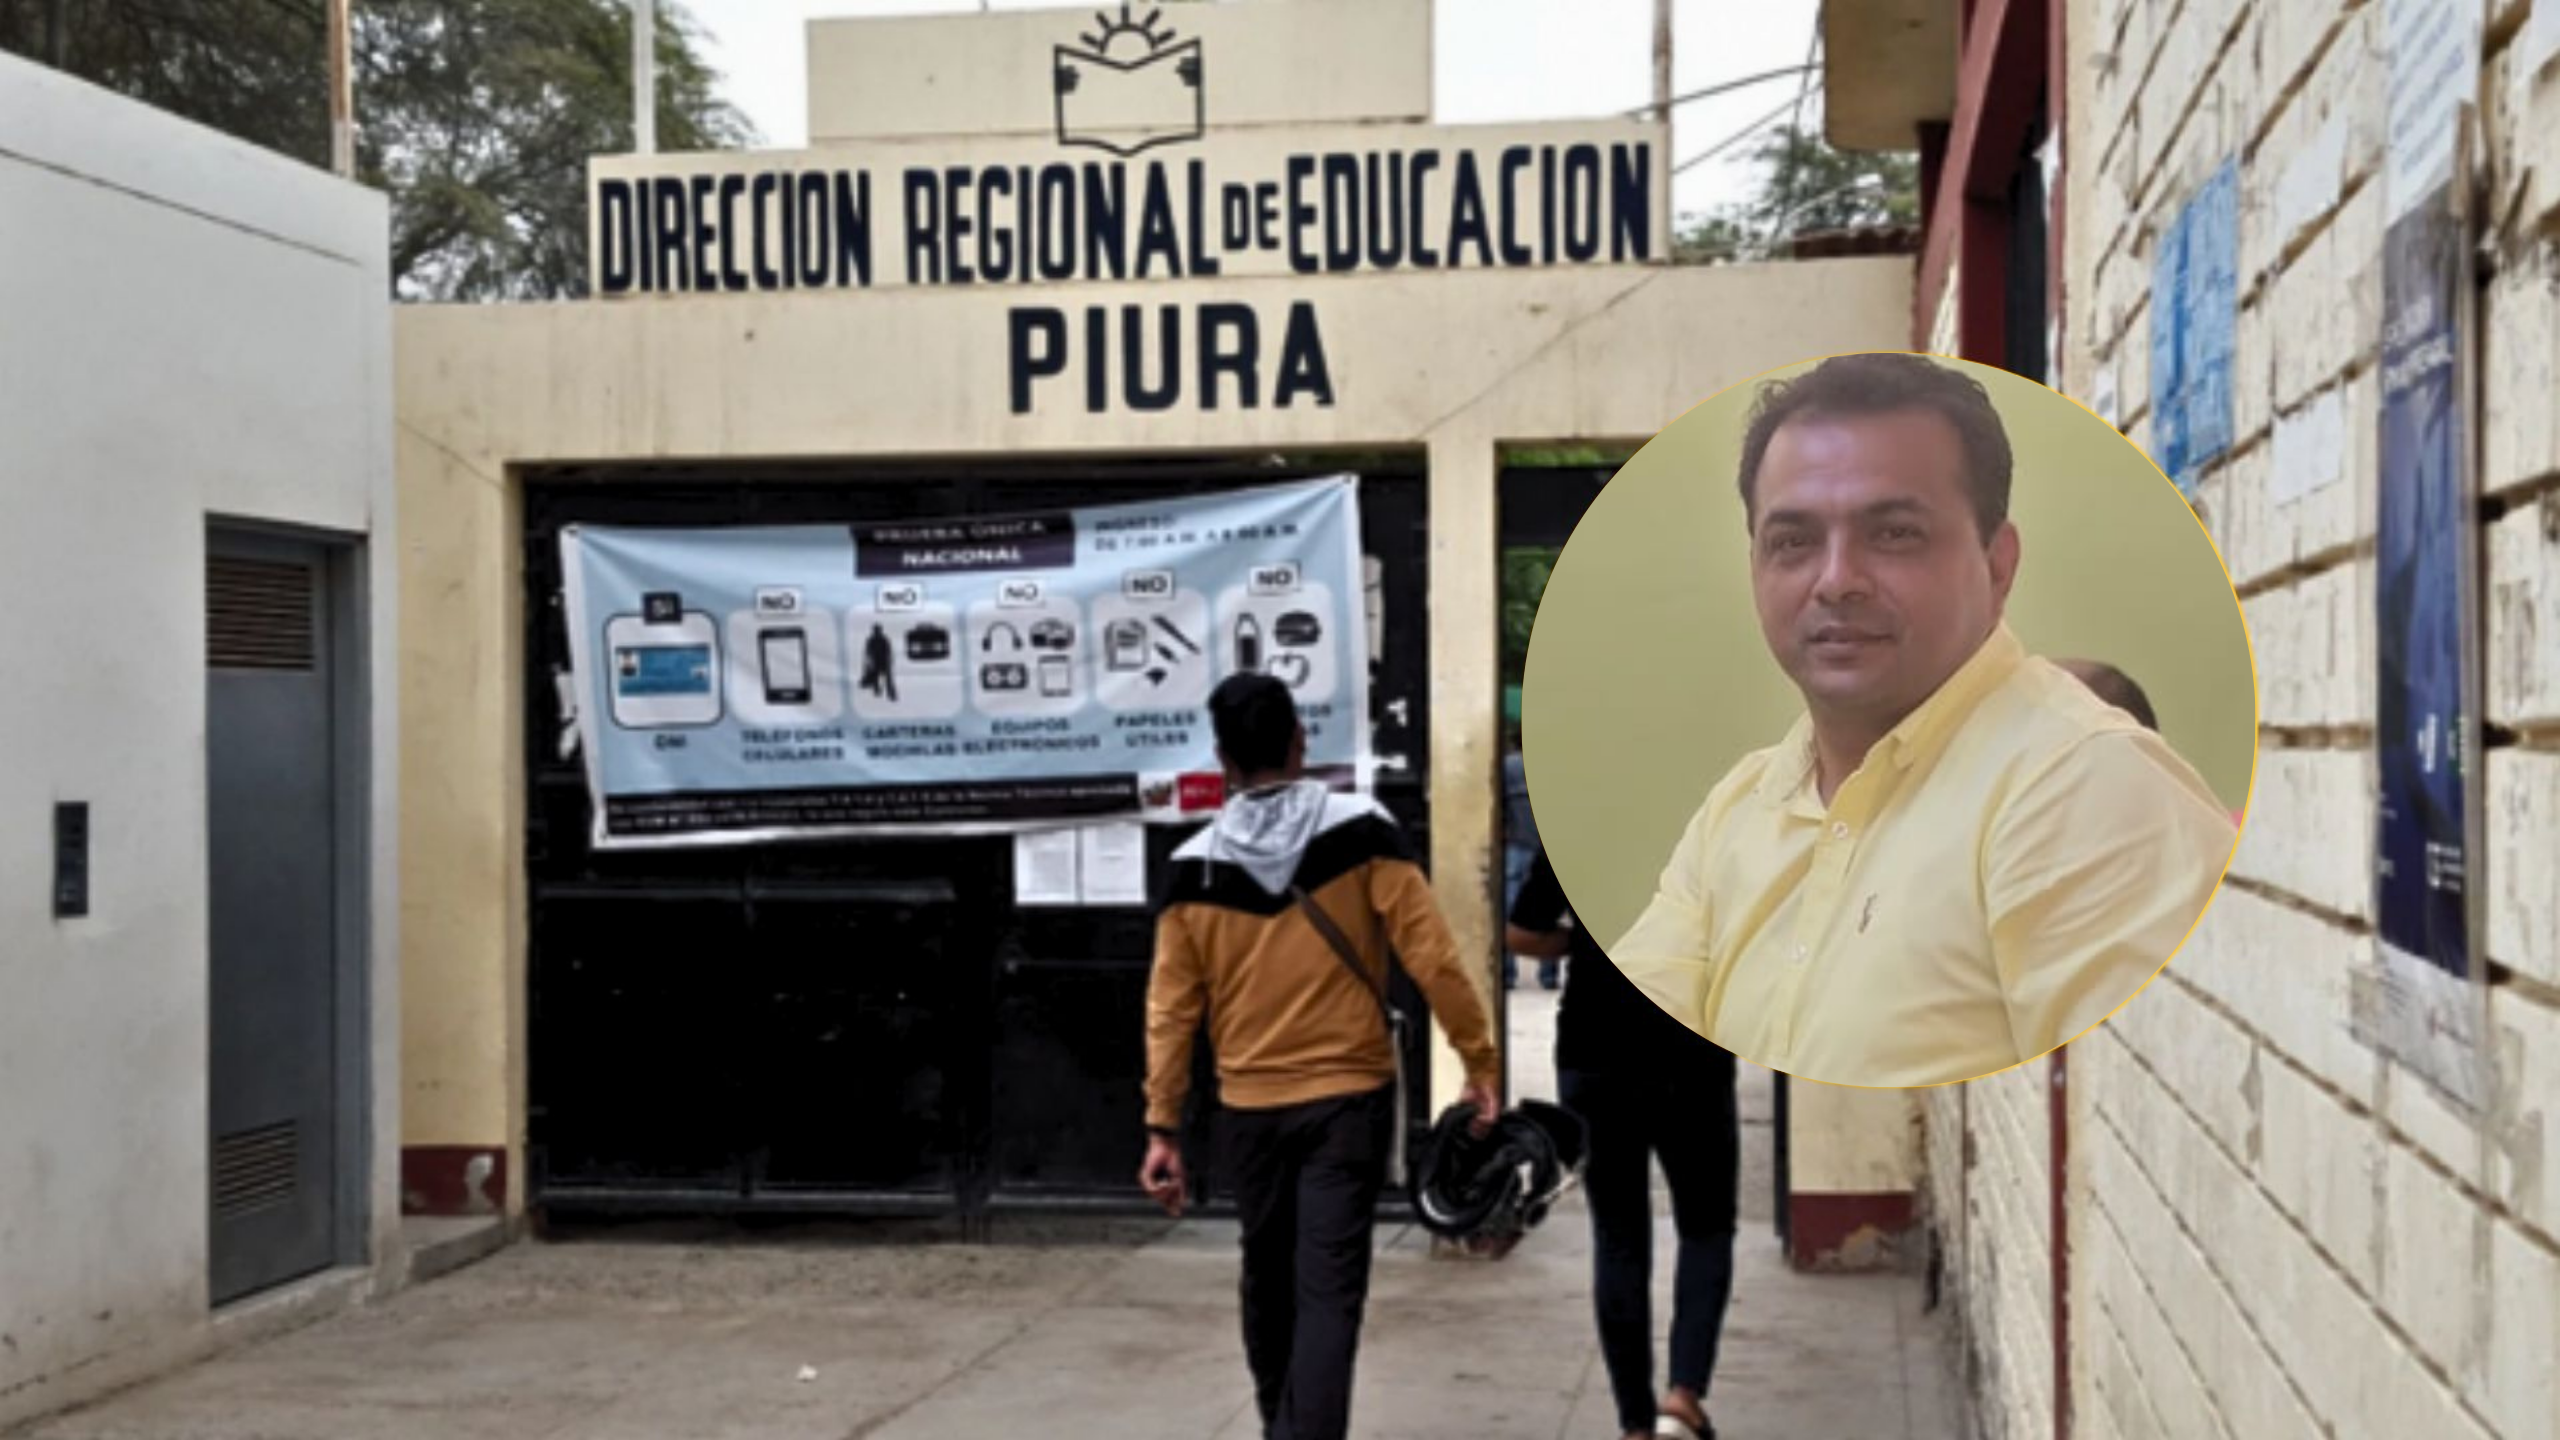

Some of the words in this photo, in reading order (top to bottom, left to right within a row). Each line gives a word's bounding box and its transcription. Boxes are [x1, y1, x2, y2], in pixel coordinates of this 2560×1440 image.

[599, 170, 871, 292] DIRECCION
[903, 159, 1220, 285] REGIONAL
[1222, 182, 1280, 251] DE
[1287, 142, 1650, 274] EDUCACION
[1009, 301, 1335, 414] PIURA
[902, 546, 1022, 566] NACIONAL
[1132, 575, 1168, 592] NO
[1256, 569, 1293, 585] NO
[884, 588, 917, 604] NO
[1004, 583, 1039, 600] NO
[761, 593, 796, 609] NO
[1114, 711, 1197, 728] PAPELES
